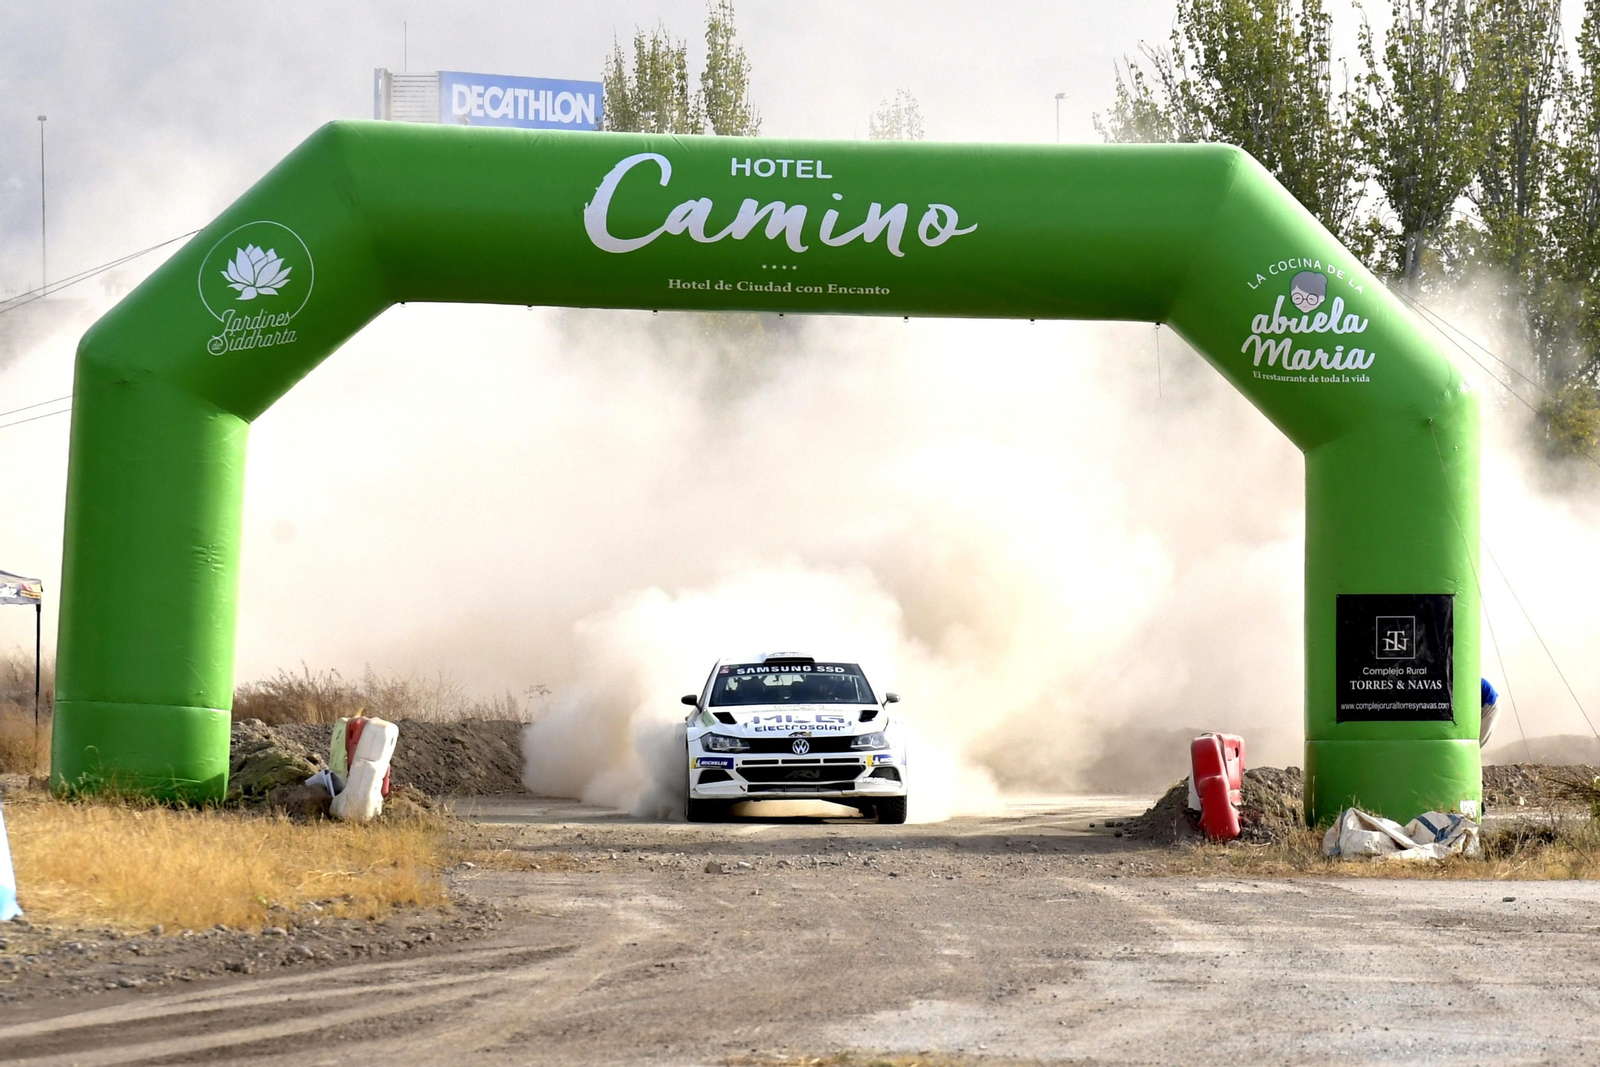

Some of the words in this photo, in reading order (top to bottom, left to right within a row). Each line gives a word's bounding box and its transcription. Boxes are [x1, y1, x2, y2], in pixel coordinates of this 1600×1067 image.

[451, 84, 595, 125] DECATHLON
[731, 157, 833, 179] HOTEL
[583, 152, 979, 258] Camino
[668, 278, 711, 291] Hotel
[714, 279, 733, 291] de
[736, 280, 792, 293] Ciudad
[795, 284, 823, 294] con
[827, 283, 891, 295] Encanto
[1247, 273, 1267, 290] LA
[1269, 258, 1322, 275] COCINA
[1327, 264, 1345, 279] DE
[1348, 278, 1364, 295] LA
[215, 309, 291, 335] Jardines
[1251, 295, 1369, 334] abuela
[207, 329, 297, 355] Siddharta
[1240, 334, 1376, 371] Maria
[1252, 371, 1262, 379] El
[1262, 373, 1307, 383] restaurante
[1309, 374, 1320, 383] de
[1321, 374, 1341, 383] toda
[1341, 374, 1350, 382] la
[1351, 374, 1370, 383] vida
[736, 665, 812, 675] SAMSUNG
[816, 665, 845, 673] SSD
[1362, 667, 1405, 676] Complejo
[1406, 666, 1427, 675] Rural
[1350, 680, 1394, 690] TORRES
[1396, 680, 1405, 690] &
[1408, 680, 1443, 690] NAVAS
[1340, 701, 1450, 711] www.complejoruraltorresynavas.com
